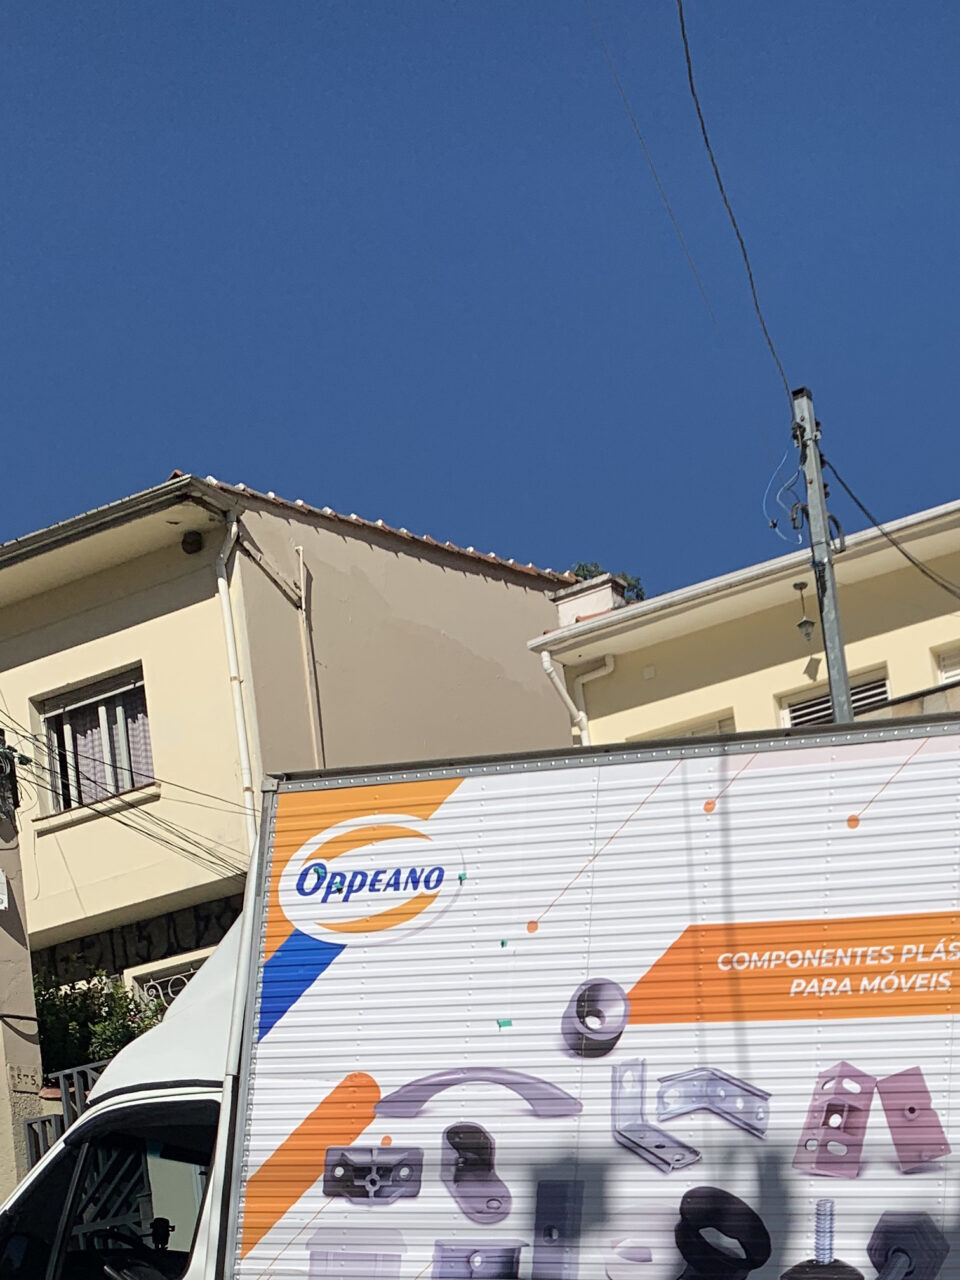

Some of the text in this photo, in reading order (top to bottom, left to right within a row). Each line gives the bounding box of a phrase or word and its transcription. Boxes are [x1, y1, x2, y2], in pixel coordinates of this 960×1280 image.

[717, 945, 895, 971] COMPONENTES
[789, 970, 953, 997] PARA MÓVEIS
